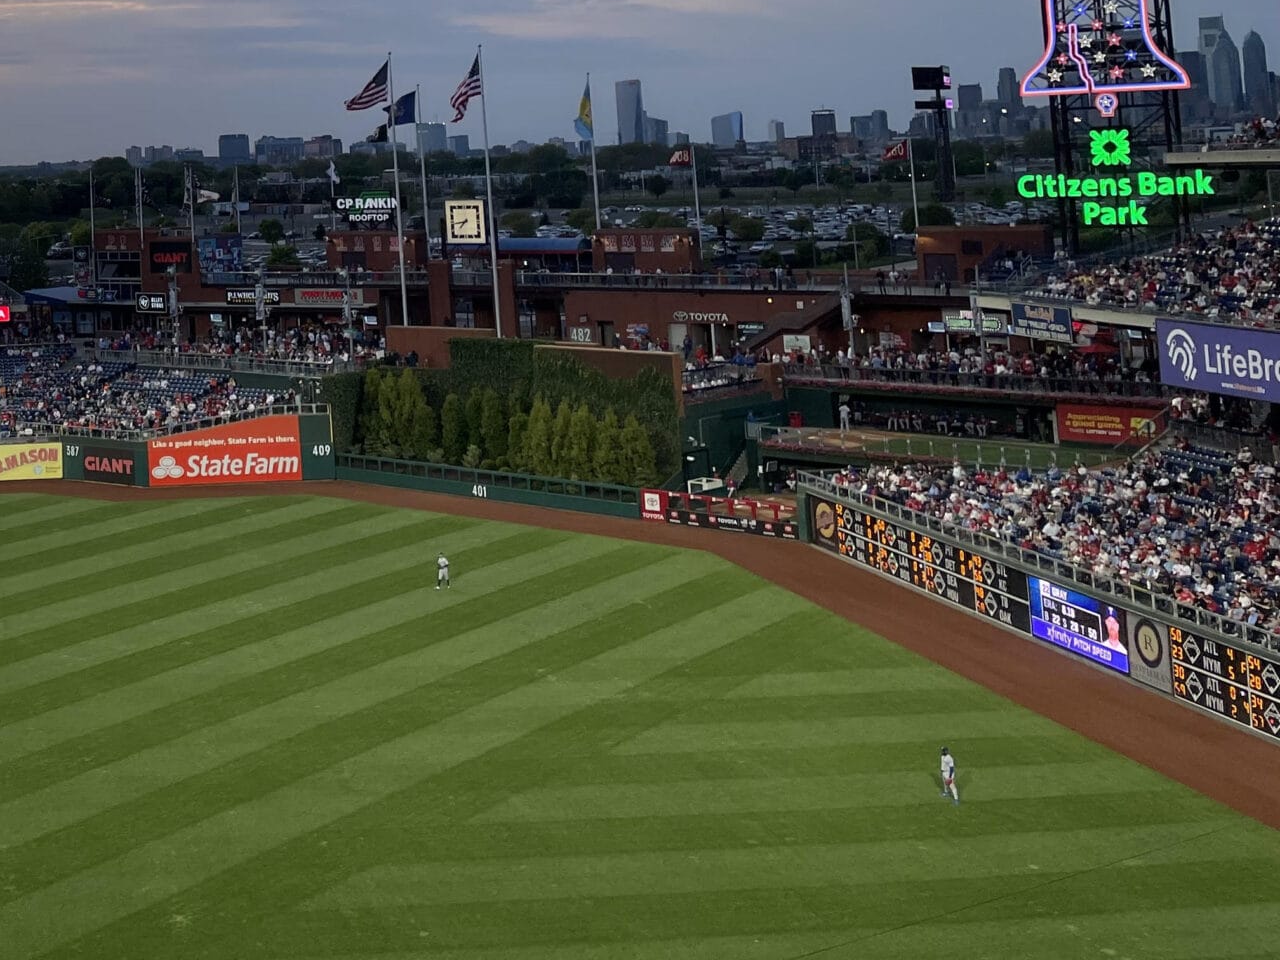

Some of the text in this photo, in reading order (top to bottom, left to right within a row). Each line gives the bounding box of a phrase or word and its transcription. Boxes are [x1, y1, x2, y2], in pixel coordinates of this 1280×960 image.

[1017, 169, 1215, 199] Citizens Bank
[336, 198, 354, 209] CP
[348, 214, 390, 222] ROOFTOP
[1083, 200, 1148, 225] Park
[153, 252, 188, 264] GIANT
[689, 312, 729, 322] TOYOTA
[570, 327, 591, 341] 482
[1067, 413, 1121, 423] Appreciating
[1072, 420, 1096, 428] good
[1097, 421, 1125, 430] game.
[174, 440, 192, 449] good
[193, 439, 226, 448] neighbor,
[228, 437, 247, 445] State
[275, 435, 297, 443] there.
[312, 444, 331, 456] 409
[66, 445, 79, 457] 387
[84, 455, 134, 475] GIANT
[471, 484, 487, 498] 401
[642, 512, 664, 521] TOYOTA
[717, 517, 738, 526] TOYOTA
[1042, 583, 1067, 600] 22 GRAY
[1047, 624, 1112, 661] xfinity PITCH SPEED
[1144, 634, 1154, 653] R
[1170, 627, 1234, 661] 50 ATL 4
[1172, 644, 1246, 680] 23 NYM 5 F
[1247, 655, 1260, 671] 54
[1173, 665, 1185, 680] 30
[1206, 677, 1222, 695] ATL
[1229, 686, 1236, 701] 0
[1249, 674, 1262, 691] 28
[1205, 693, 1225, 713] NYM
[1231, 704, 1237, 718] 2
[1251, 694, 1263, 711] 34
[1252, 712, 1265, 728] 57
